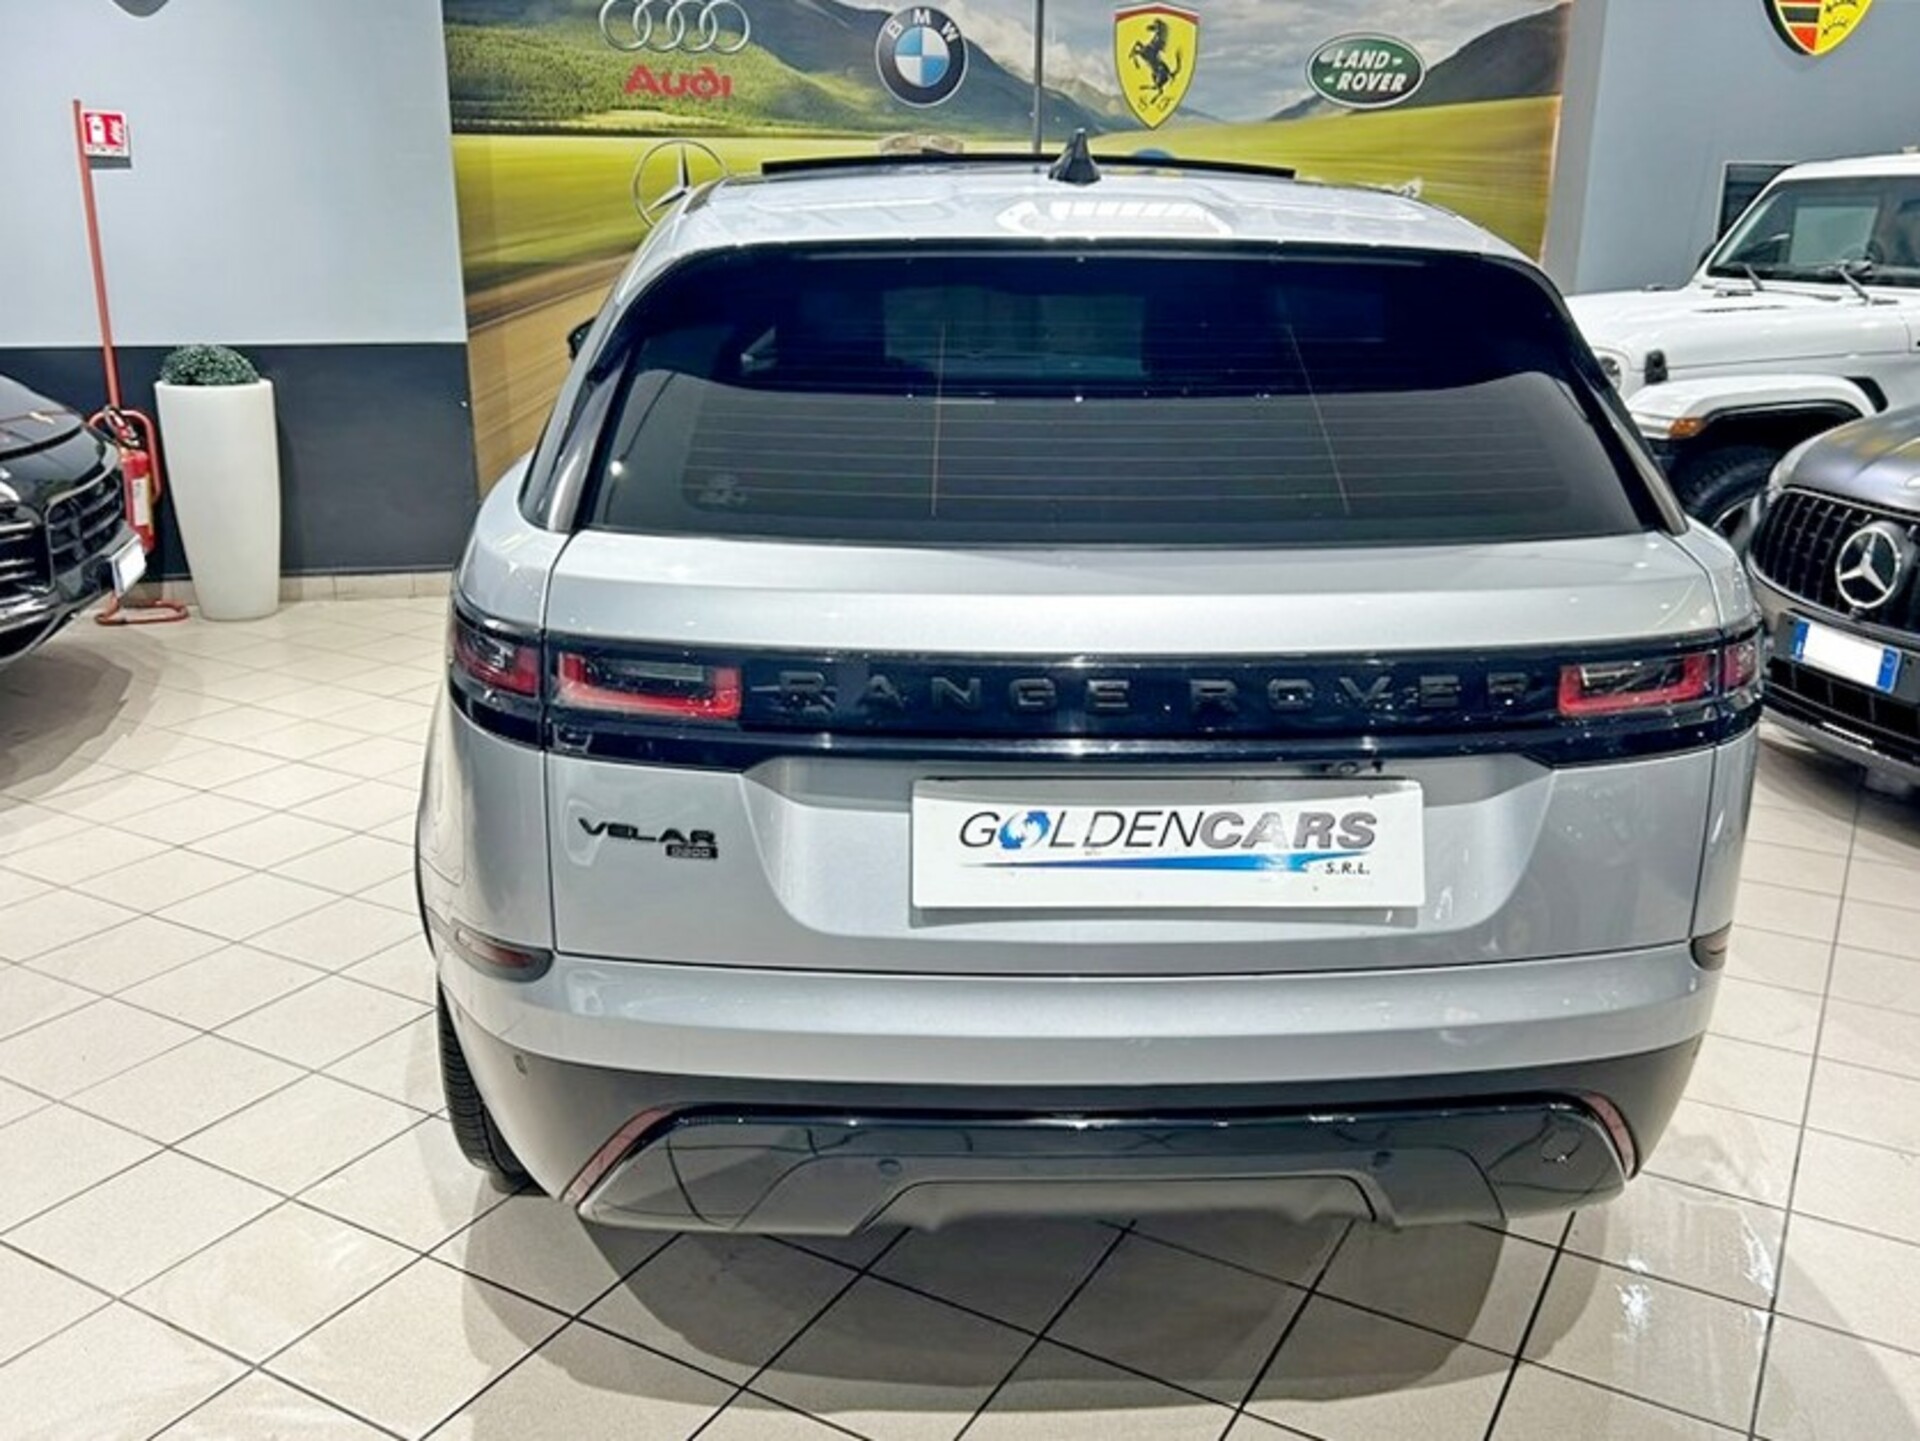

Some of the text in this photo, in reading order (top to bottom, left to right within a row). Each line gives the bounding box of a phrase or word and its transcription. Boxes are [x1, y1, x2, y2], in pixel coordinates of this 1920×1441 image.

[887, 8, 961, 42] BMW
[1331, 50, 1390, 69] LAND
[624, 64, 732, 98] Audi
[1336, 73, 1407, 92] ROVER
[777, 669, 1530, 711] RANGE ROVER
[578, 817, 717, 845] VELAR
[1325, 861, 1371, 876] S.R.L.
